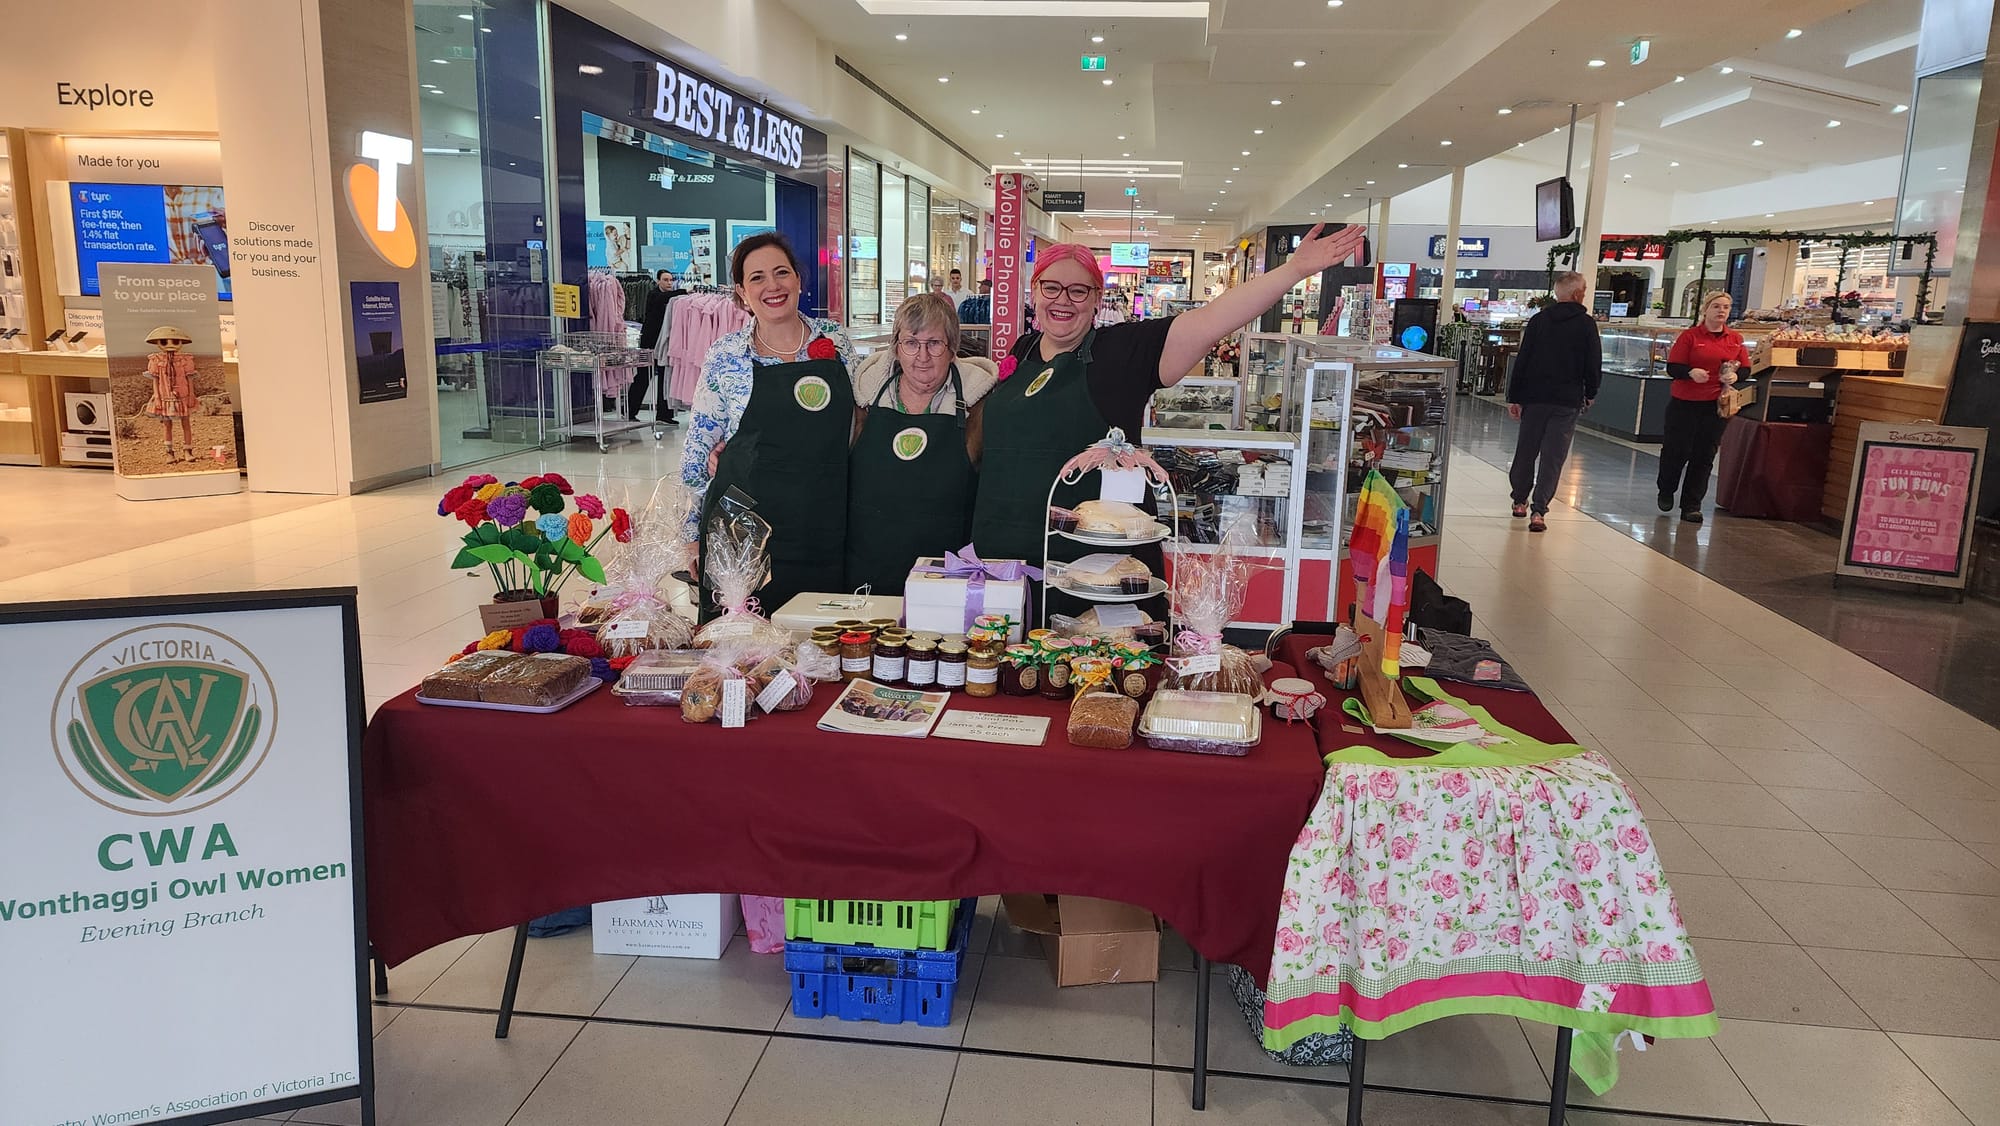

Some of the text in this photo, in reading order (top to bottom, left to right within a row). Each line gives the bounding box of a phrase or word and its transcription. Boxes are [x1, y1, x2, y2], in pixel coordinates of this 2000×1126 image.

[57, 82, 154, 110] Explore
[653, 62, 803, 169] BEST & LESS
[78, 155, 160, 170] Made for you
[649, 173, 714, 183] BET & LESS
[91, 192, 111, 204] tyro
[80, 209, 123, 220] First $15K
[81, 219, 142, 231] fee-free, then
[249, 221, 295, 232] Discover
[82, 230, 119, 240] 1.4% flat
[672, 231, 681, 239] Go
[84, 240, 157, 252] transaction rate.
[234, 236, 313, 249] solutions made
[232, 250, 317, 266] for you and your
[675, 251, 689, 260] BAG
[251, 267, 301, 278] business.
[992, 182, 1017, 365] Mobile Phone Rep
[117, 275, 201, 289] From space
[113, 290, 207, 302] to your place
[570, 295, 577, 312] 5
[68, 313, 96, 321] Discover
[1880, 477, 1951, 497] FUN BUNS
[1862, 550, 1904, 563] 100%
[1864, 568, 1895, 580] We're
[1896, 570, 1913, 581] for
[112, 640, 216, 666] VICTORIA
[987, 724, 1037, 732] Preserves
[97, 822, 239, 872] CWA
[168, 872, 227, 900] Owl
[236, 860, 347, 890] Women
[80, 903, 266, 943] Evening Branch
[611, 917, 704, 930] HARMAN WINES
[165, 1089, 248, 1114] Association
[252, 1083, 269, 1098] of
[271, 1075, 325, 1095] Victoria
[329, 1068, 357, 1085] Inc.
